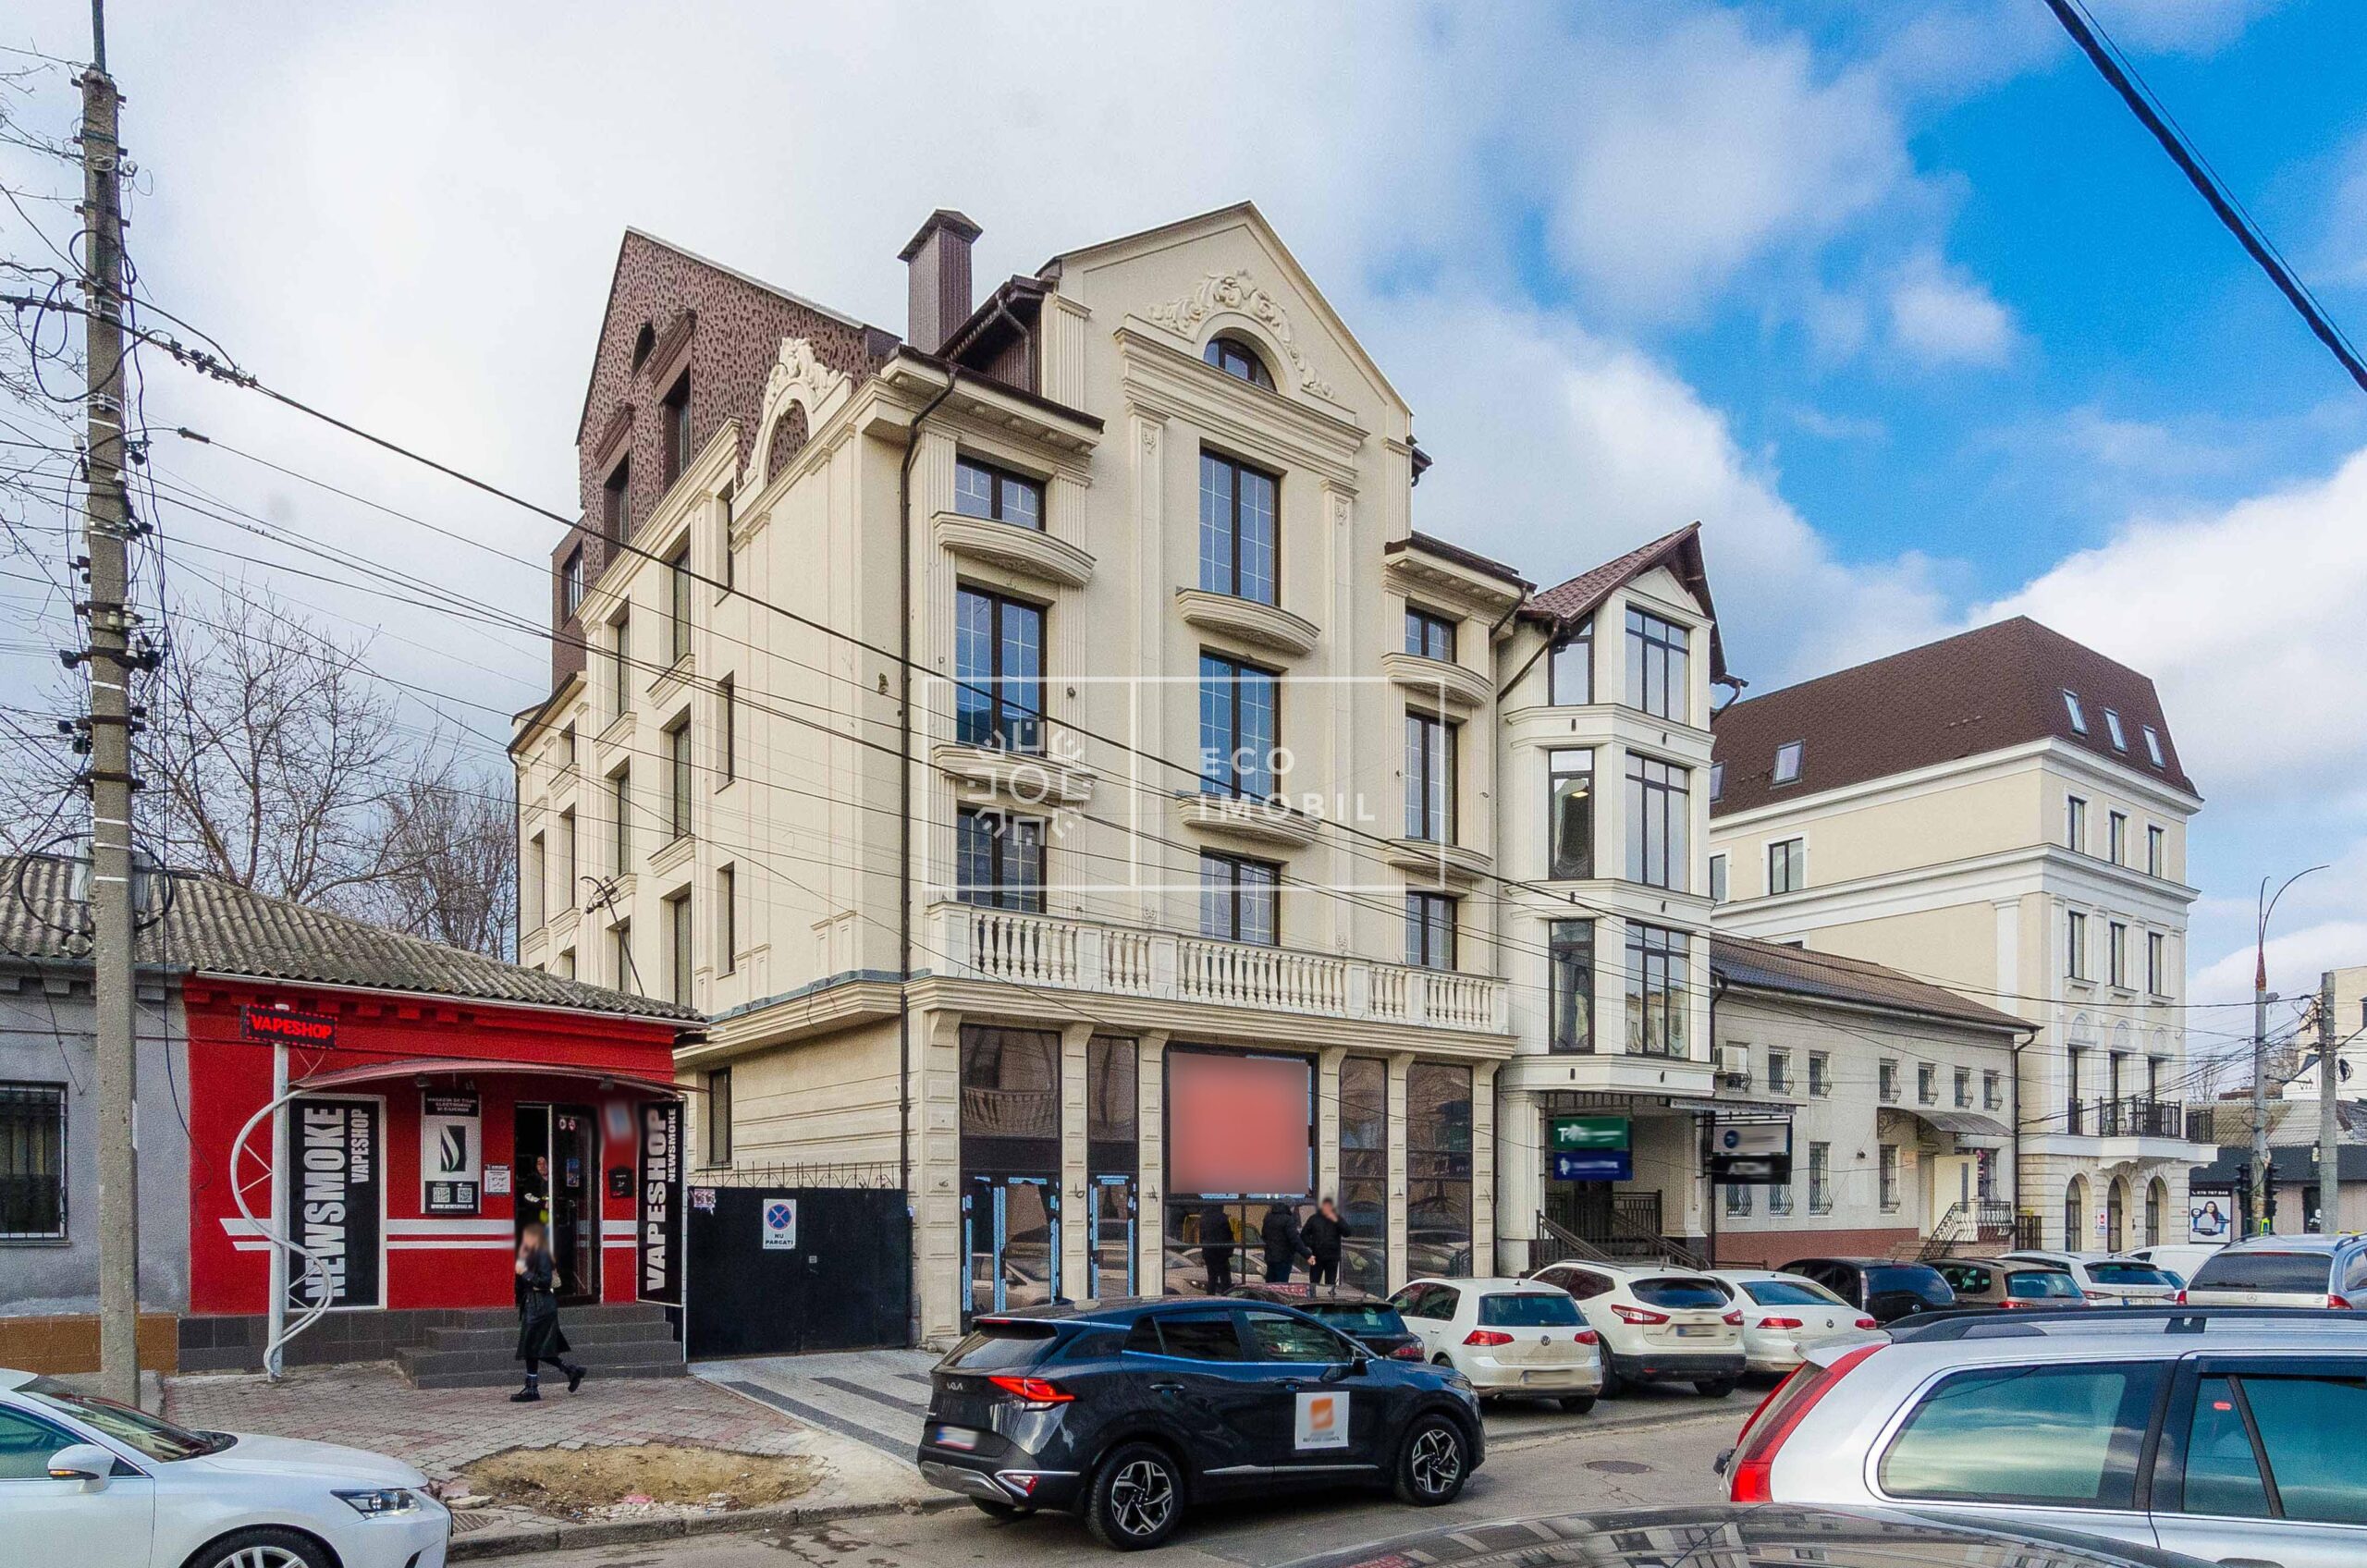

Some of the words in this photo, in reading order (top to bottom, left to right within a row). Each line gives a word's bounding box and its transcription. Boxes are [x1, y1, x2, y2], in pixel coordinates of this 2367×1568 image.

[251, 1014, 333, 1040] VAPESHOP
[350, 1109, 370, 1183] VAPESHOP
[668, 1109, 677, 1182] NEWSMOKE
[303, 1108, 346, 1298] NEWSMOKE
[646, 1108, 667, 1292] VAPESHOP
